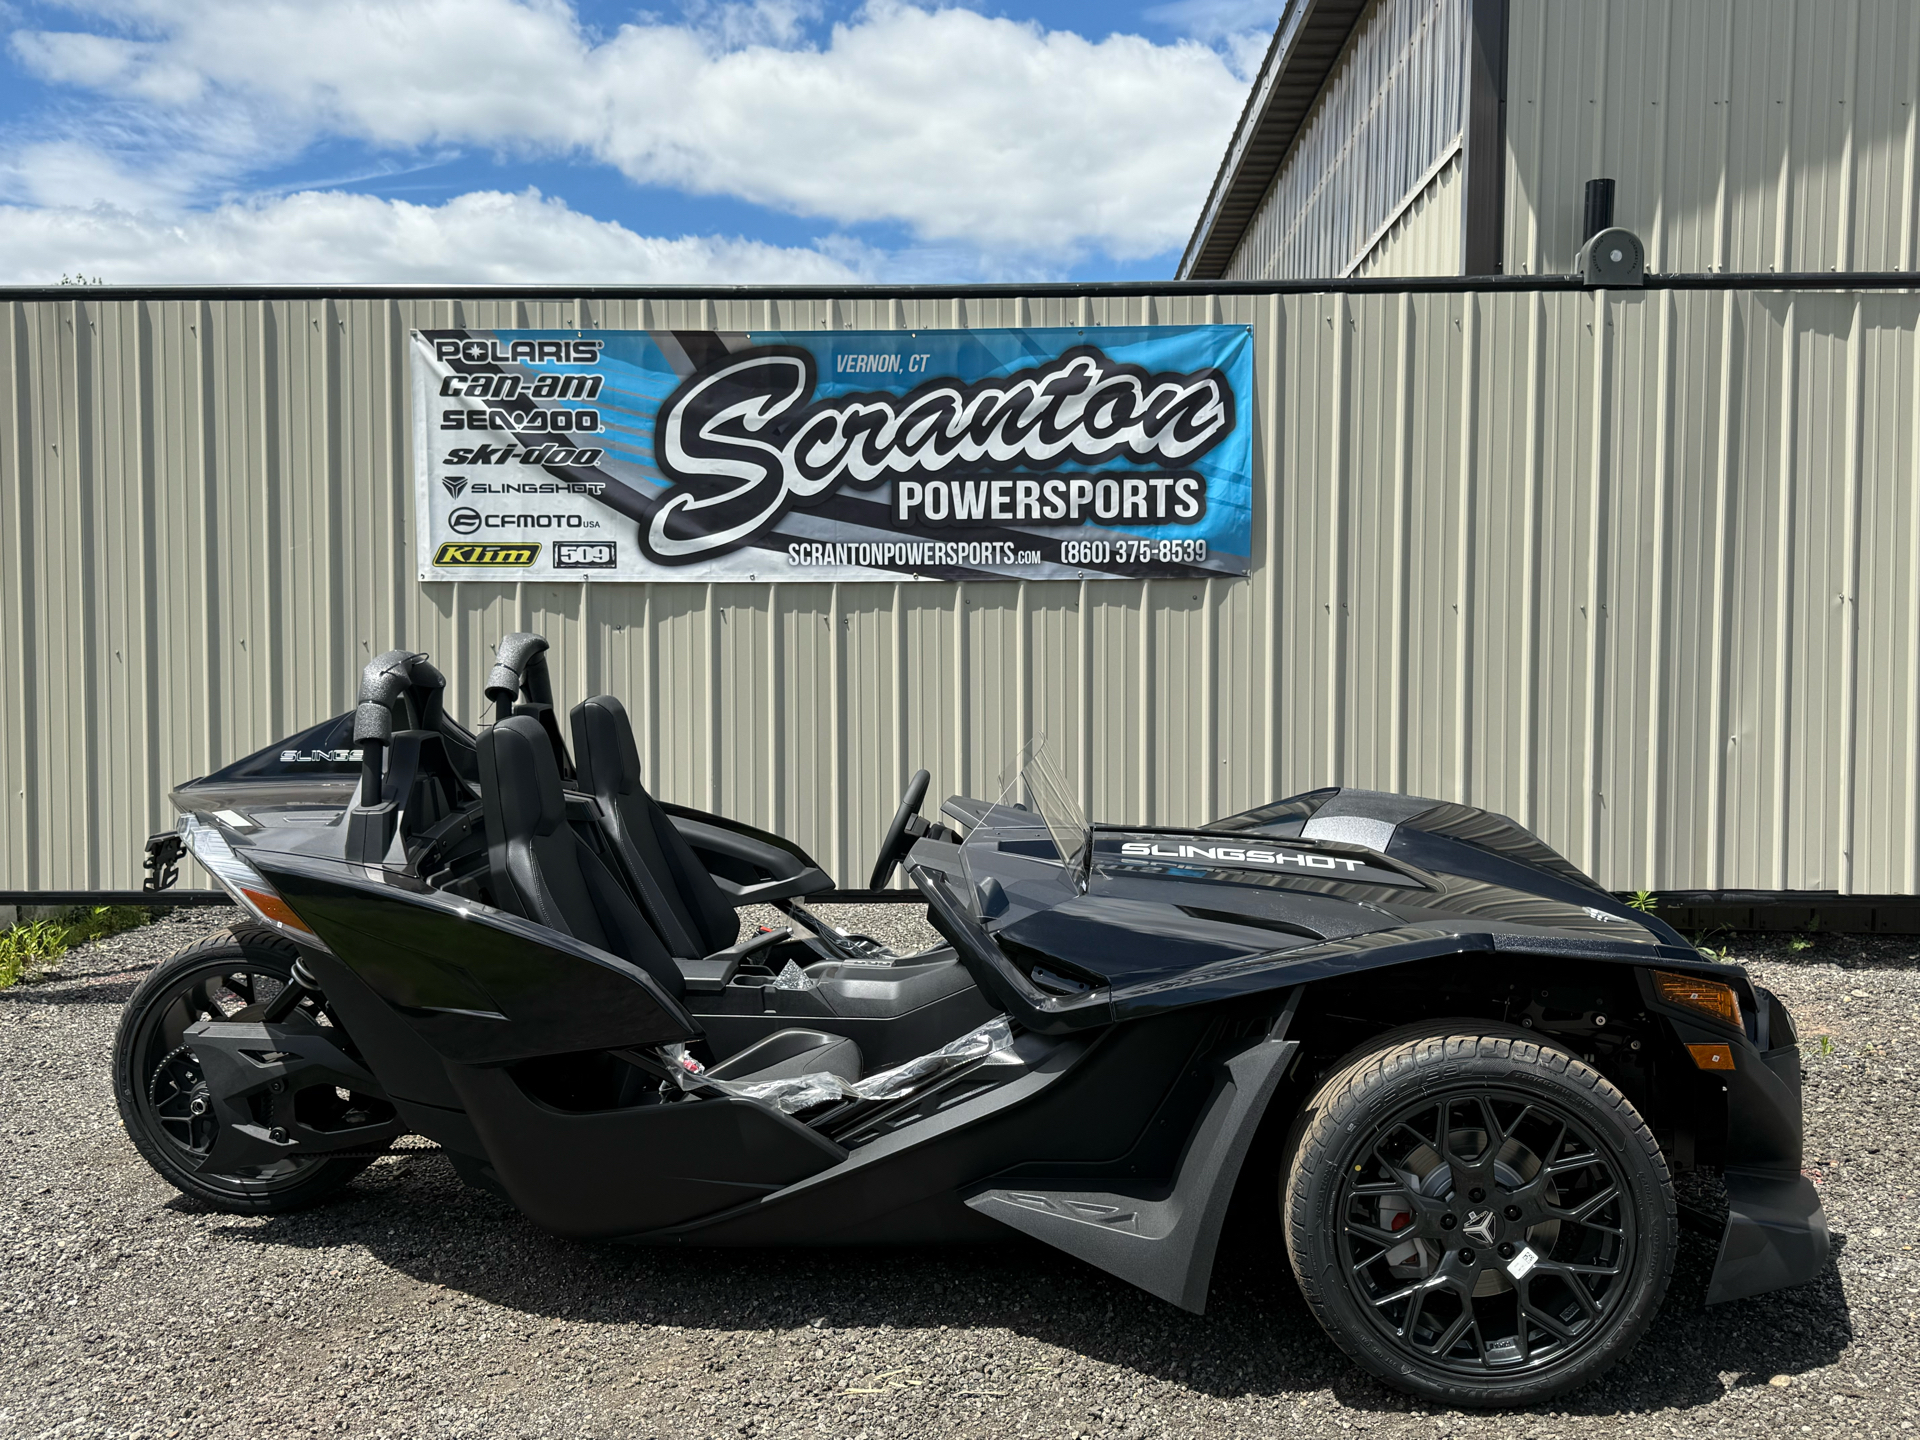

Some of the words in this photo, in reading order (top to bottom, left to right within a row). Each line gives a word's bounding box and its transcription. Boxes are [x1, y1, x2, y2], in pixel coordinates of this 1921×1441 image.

[435, 340, 600, 364] POLARIS
[837, 355, 904, 374] VERNON,
[909, 354, 930, 372] CT
[439, 373, 604, 400] can-am
[442, 444, 602, 466] ski-doo
[648, 354, 1227, 557] Scranton
[471, 483, 605, 495] SLINGSHOT
[899, 478, 1200, 521] POWERSPORTS
[442, 546, 532, 563] Klim
[560, 546, 610, 564] 509
[1060, 541, 1111, 564] (860)
[1115, 539, 1207, 563] 375-8539
[1121, 842, 1366, 872] SLINGSHOT
